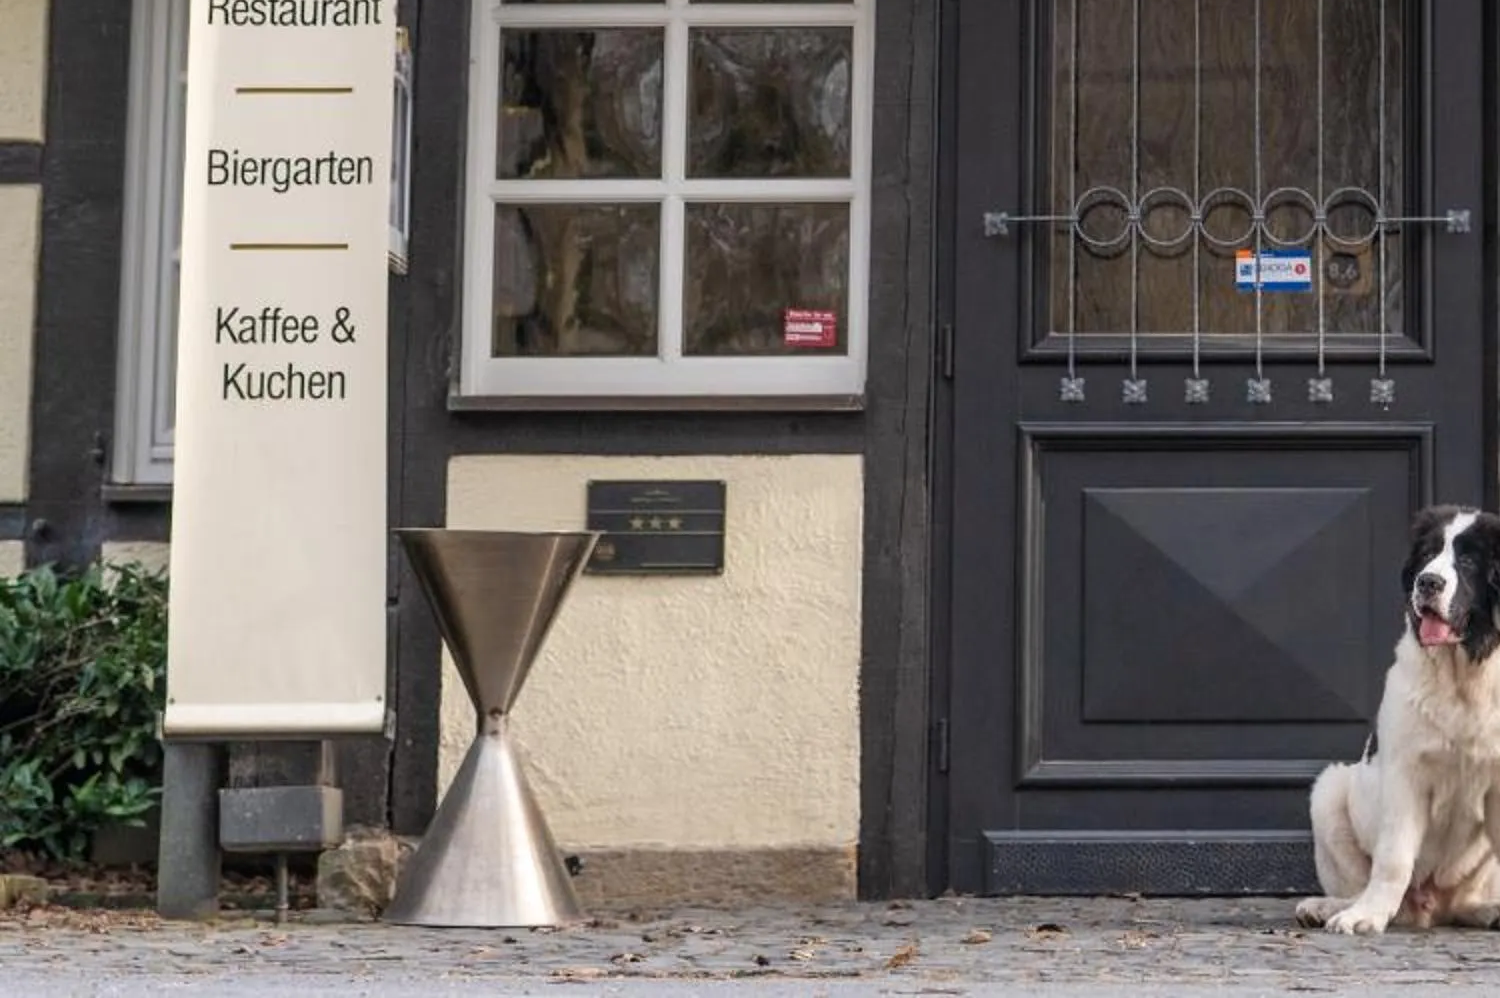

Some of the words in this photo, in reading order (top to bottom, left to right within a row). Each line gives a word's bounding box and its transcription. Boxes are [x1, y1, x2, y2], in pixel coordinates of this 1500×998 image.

[206, 149, 374, 193] Biergarten
[215, 307, 319, 344] Kaffee
[331, 307, 356, 343] &
[222, 363, 347, 400] Kuchen
